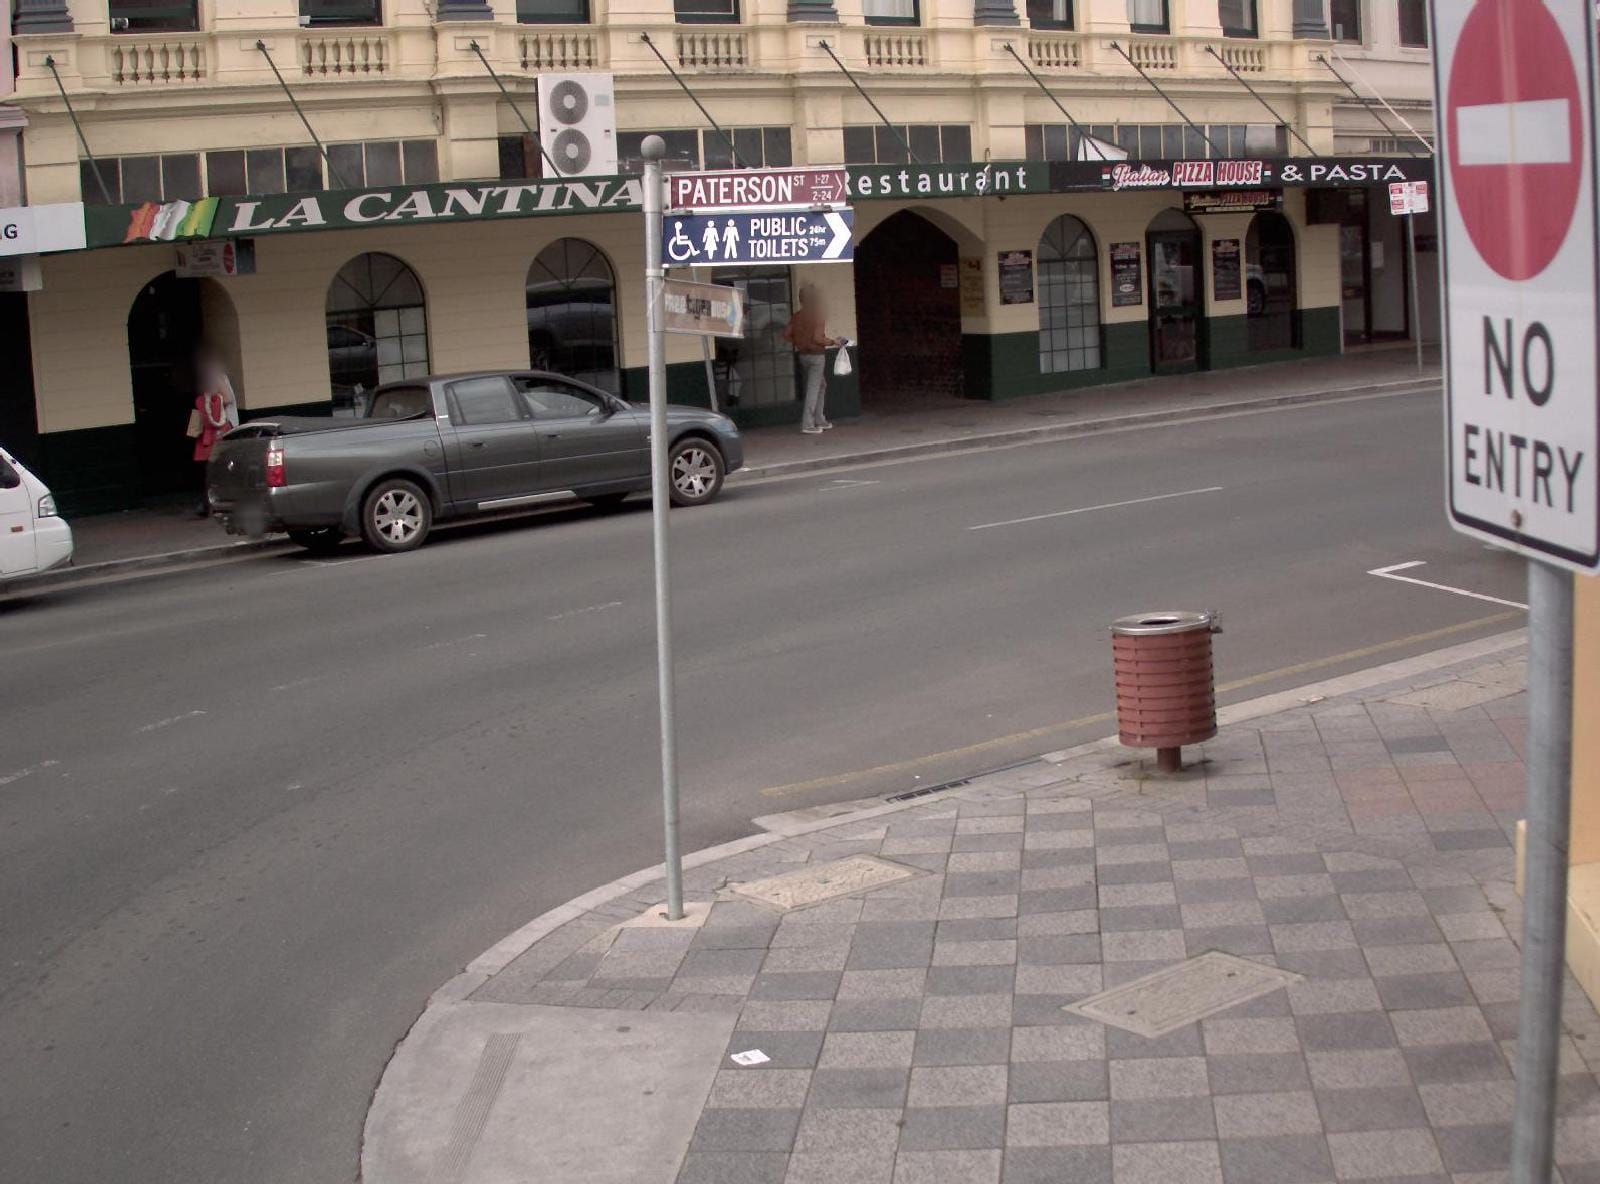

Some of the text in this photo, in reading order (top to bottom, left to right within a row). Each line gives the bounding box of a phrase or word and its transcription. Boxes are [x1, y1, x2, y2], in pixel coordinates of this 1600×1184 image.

[814, 174, 830, 185] 1-27
[1112, 161, 1262, 193] Italian PIZZA HOUSE
[1280, 163, 1407, 182] & PASTA
[678, 175, 806, 205] PATERSON ST
[812, 190, 833, 202] 2-24
[227, 179, 642, 232] LA CANTINA
[750, 217, 807, 237] PUBLIC
[748, 238, 808, 259] TOILETS
[1483, 315, 1555, 408] NO
[1464, 423, 1584, 514] ENTRY
